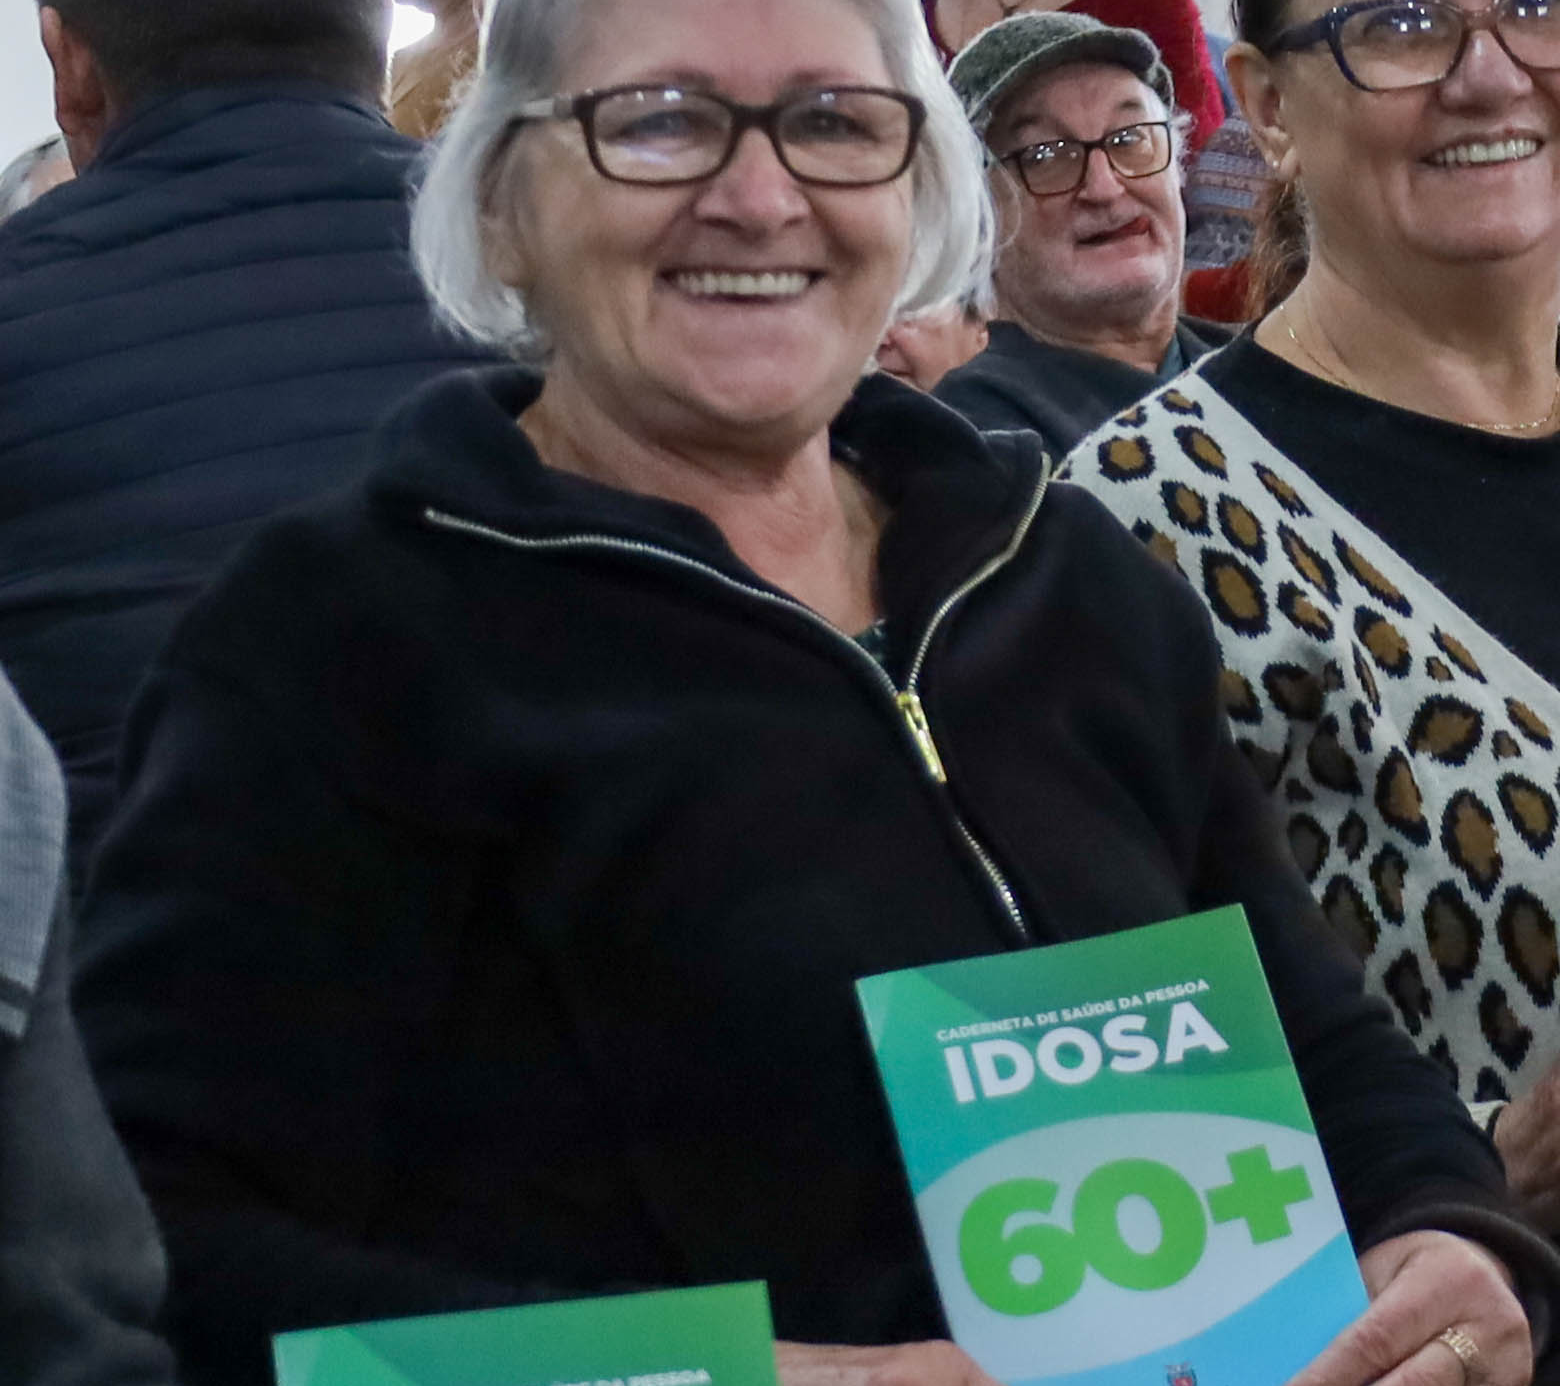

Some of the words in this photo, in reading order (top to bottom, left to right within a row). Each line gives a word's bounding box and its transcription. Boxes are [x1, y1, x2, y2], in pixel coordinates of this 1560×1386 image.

[936, 1016, 1035, 1043] CADERNETA
[1036, 1011, 1059, 1026] DE
[1061, 1001, 1116, 1022] SAÚDE
[1118, 993, 1143, 1010] DA
[1145, 979, 1210, 1004] PESSOA
[943, 1000, 1229, 1104] IDOSA
[958, 1144, 1314, 1316] 60+
